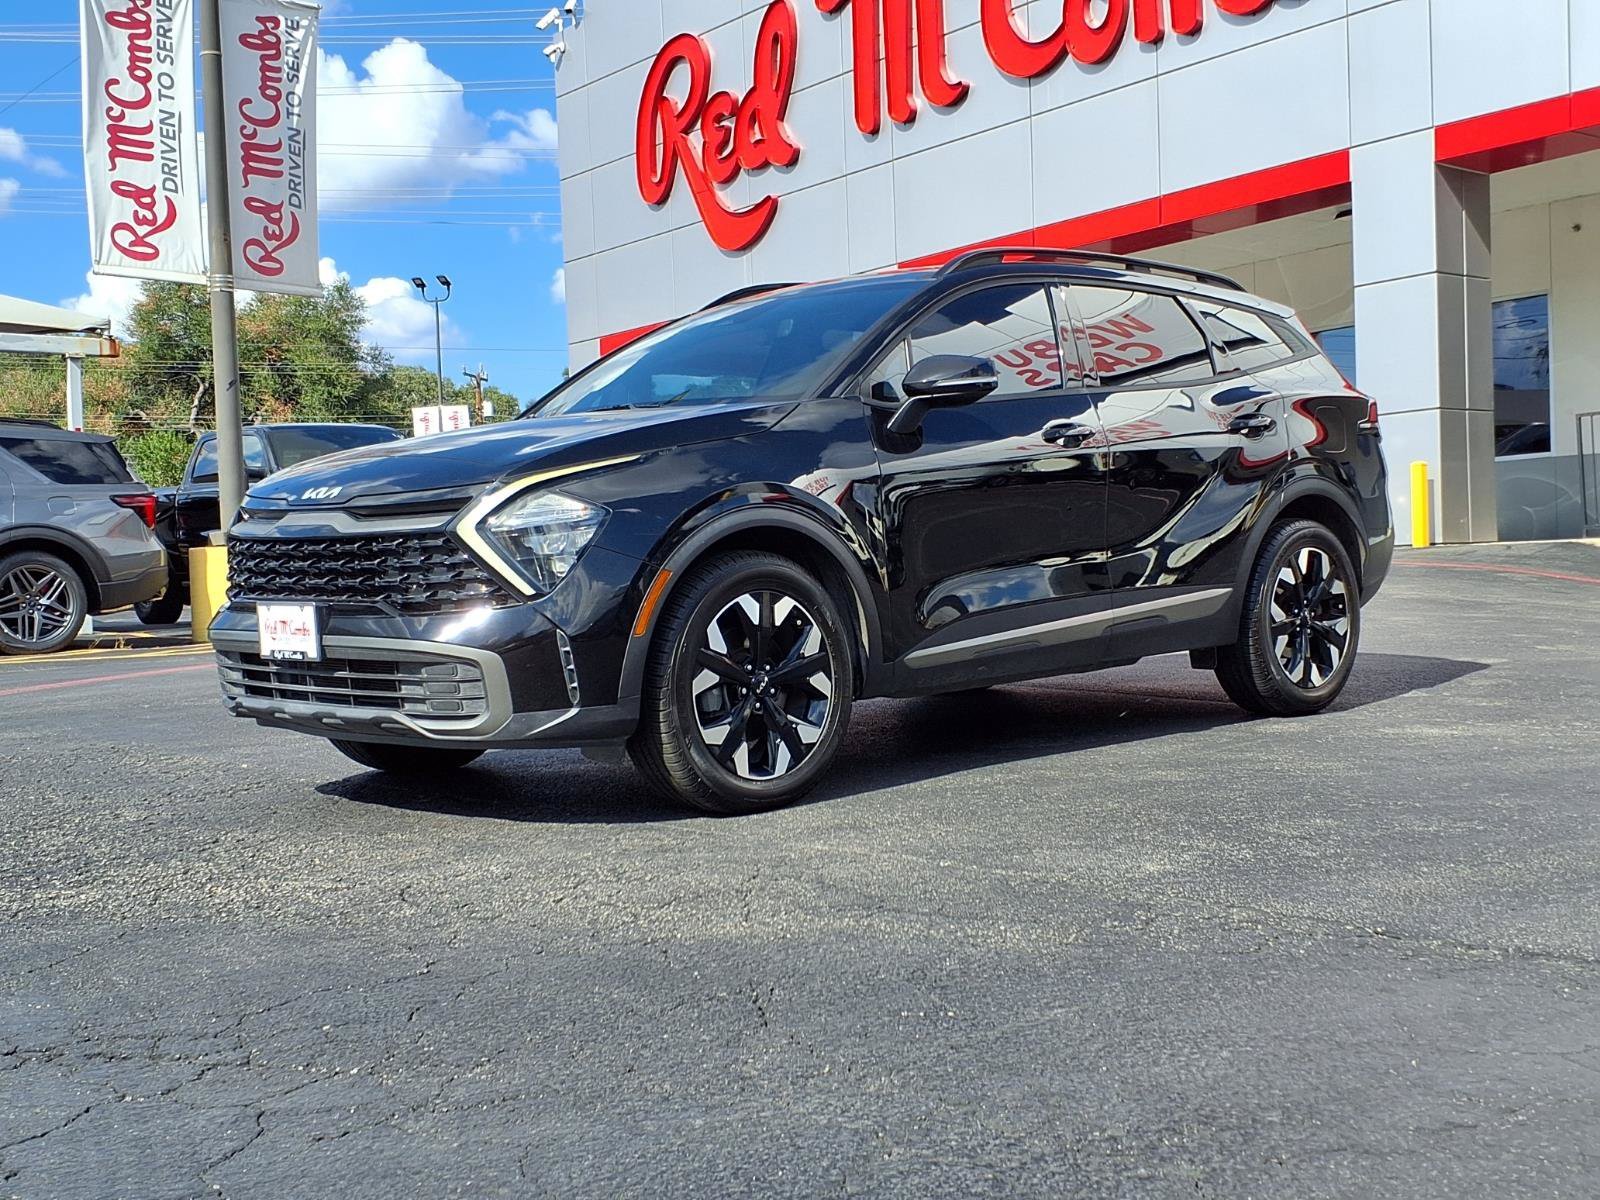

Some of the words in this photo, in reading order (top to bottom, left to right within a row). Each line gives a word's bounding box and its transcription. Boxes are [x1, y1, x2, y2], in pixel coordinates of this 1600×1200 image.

[156, 0, 175, 67] SERVE
[284, 16, 301, 83] SERVE
[156, 71, 176, 105] TO
[238, 15, 285, 189] McCombs
[285, 90, 302, 121] TO
[636, 0, 801, 252] Red
[158, 108, 180, 196] DRIVEN
[287, 126, 303, 211] DRIVEN
[110, 180, 177, 262] Red
[242, 196, 301, 277] Red
[301, 486, 344, 500] KIA
